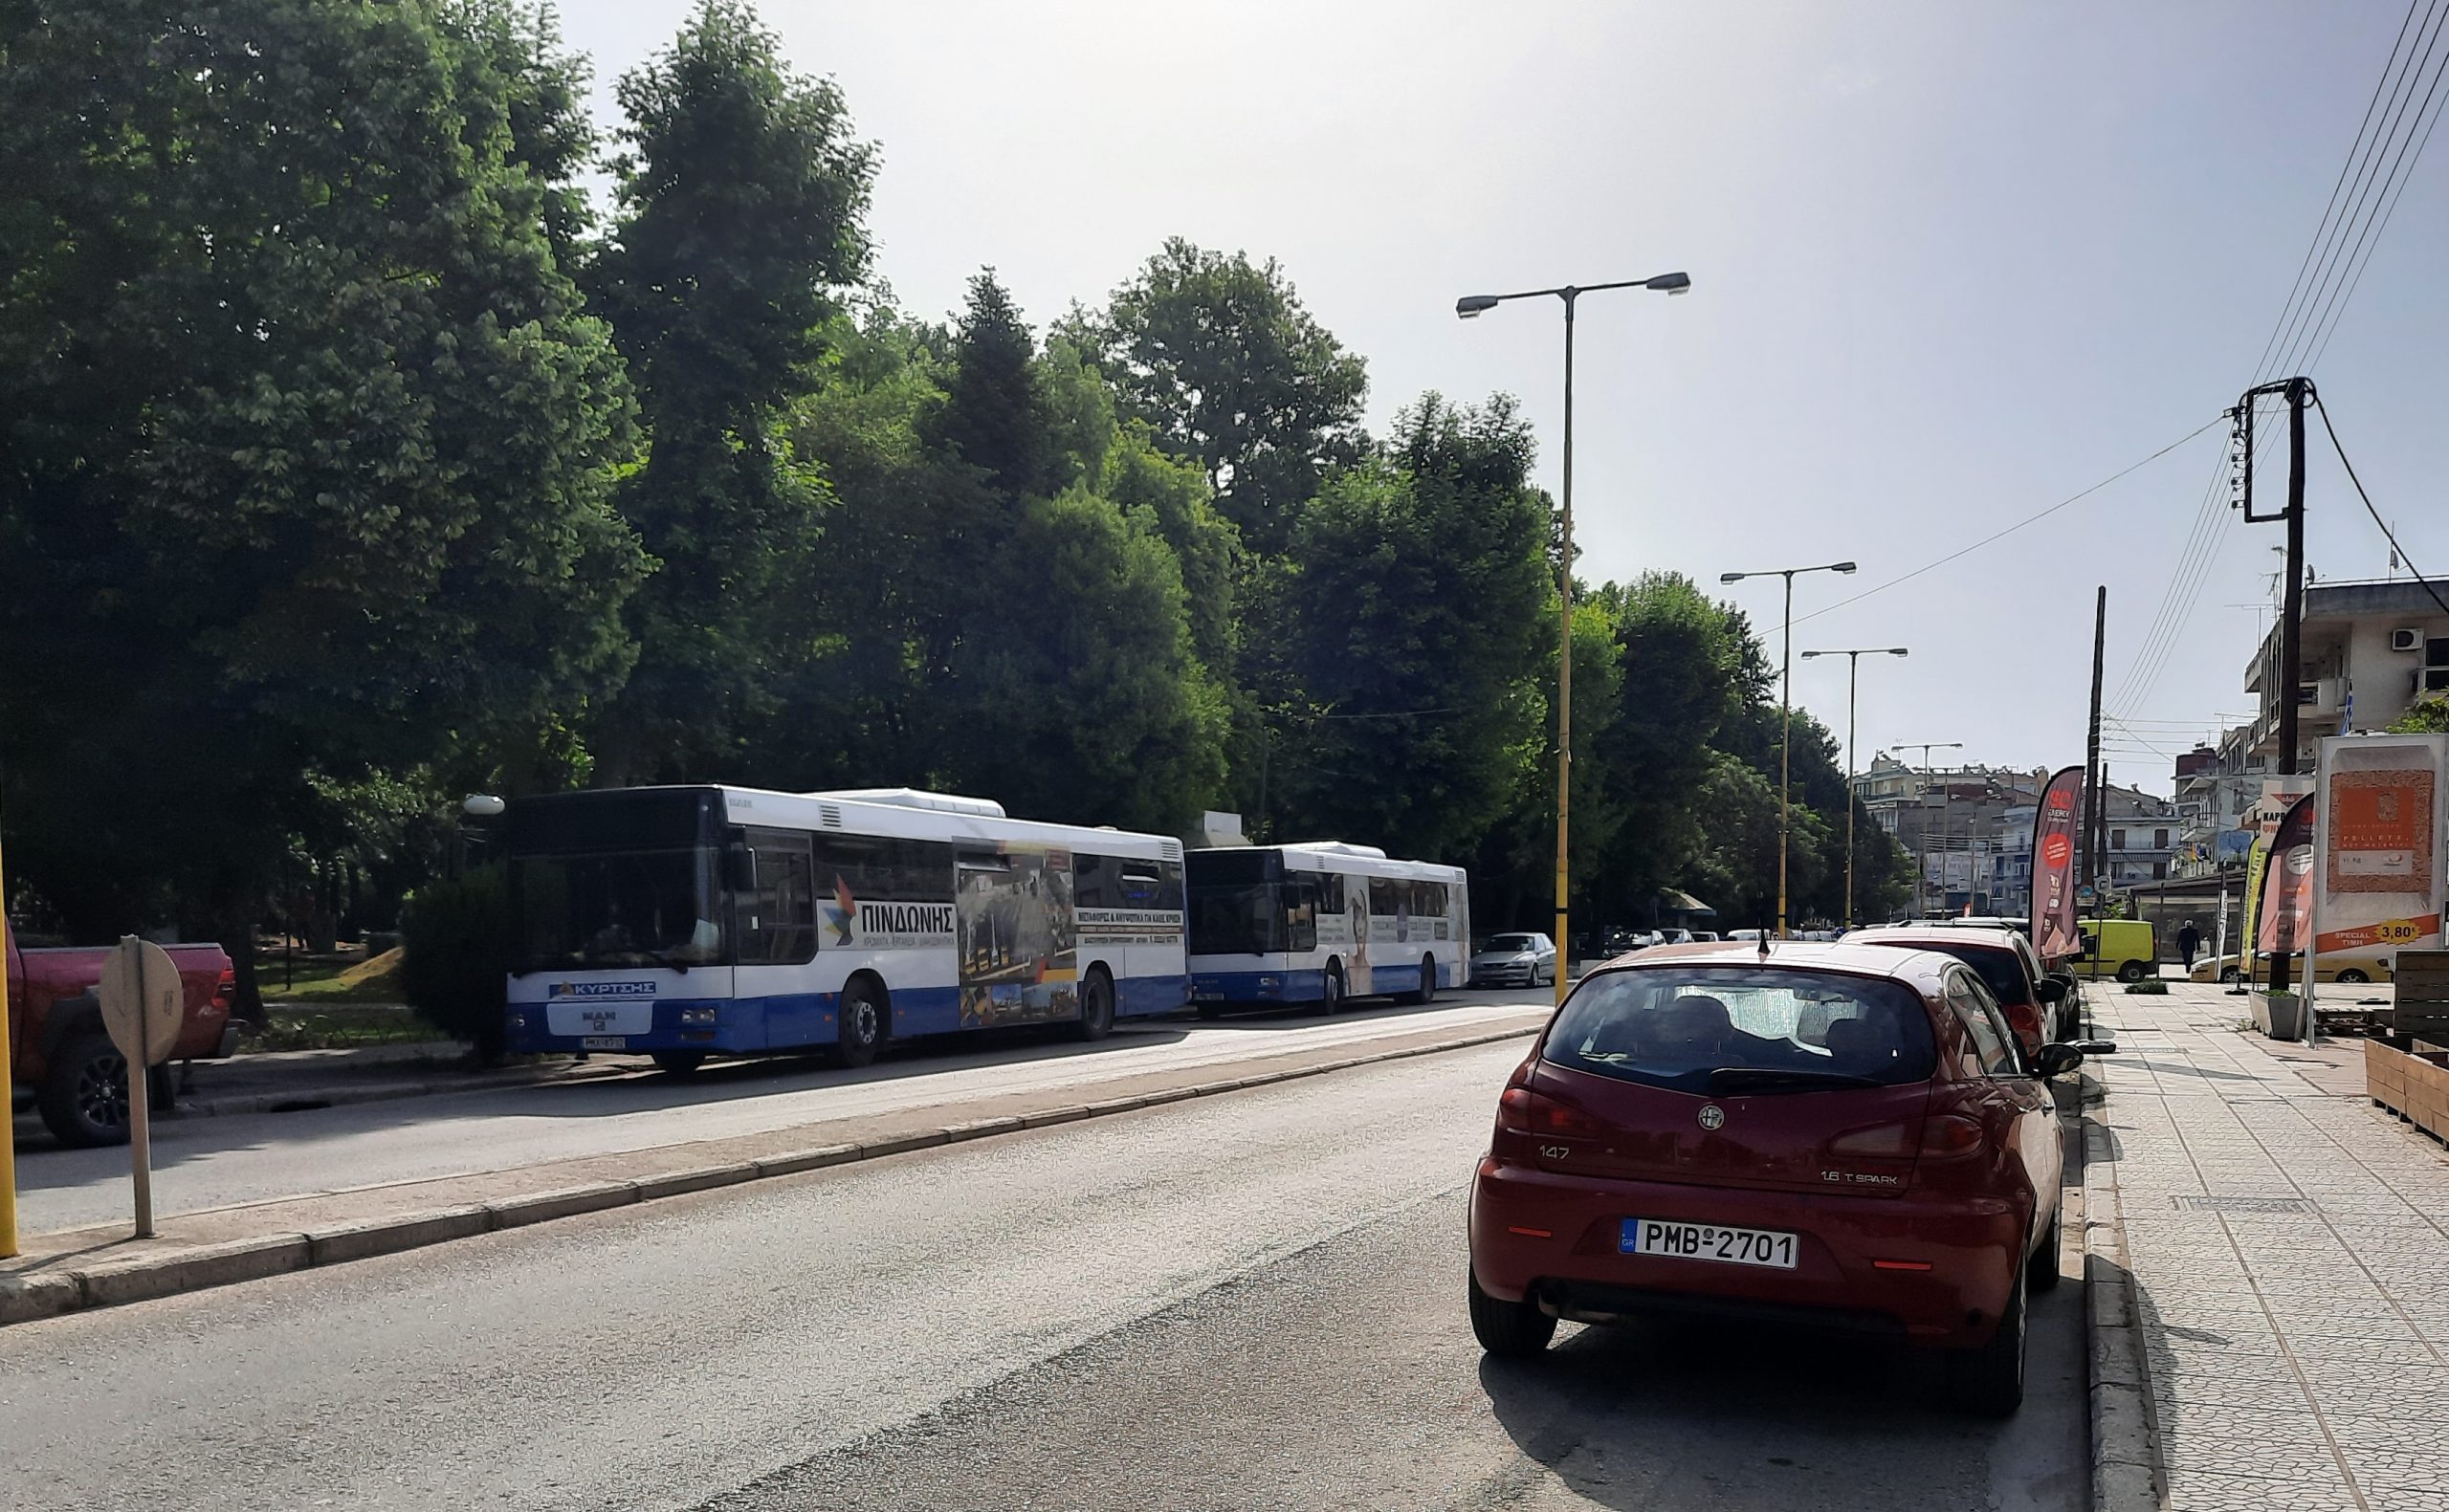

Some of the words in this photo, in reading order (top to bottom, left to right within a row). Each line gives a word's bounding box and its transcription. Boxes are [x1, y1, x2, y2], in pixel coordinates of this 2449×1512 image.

[862, 905, 954, 933] ΠΙΝΔΩΝΗΣ
[575, 982, 654, 995] ΚΥΡΤΣΗΣ
[1539, 1145, 1569, 1159] 147
[1622, 1238, 1635, 1247] GR
